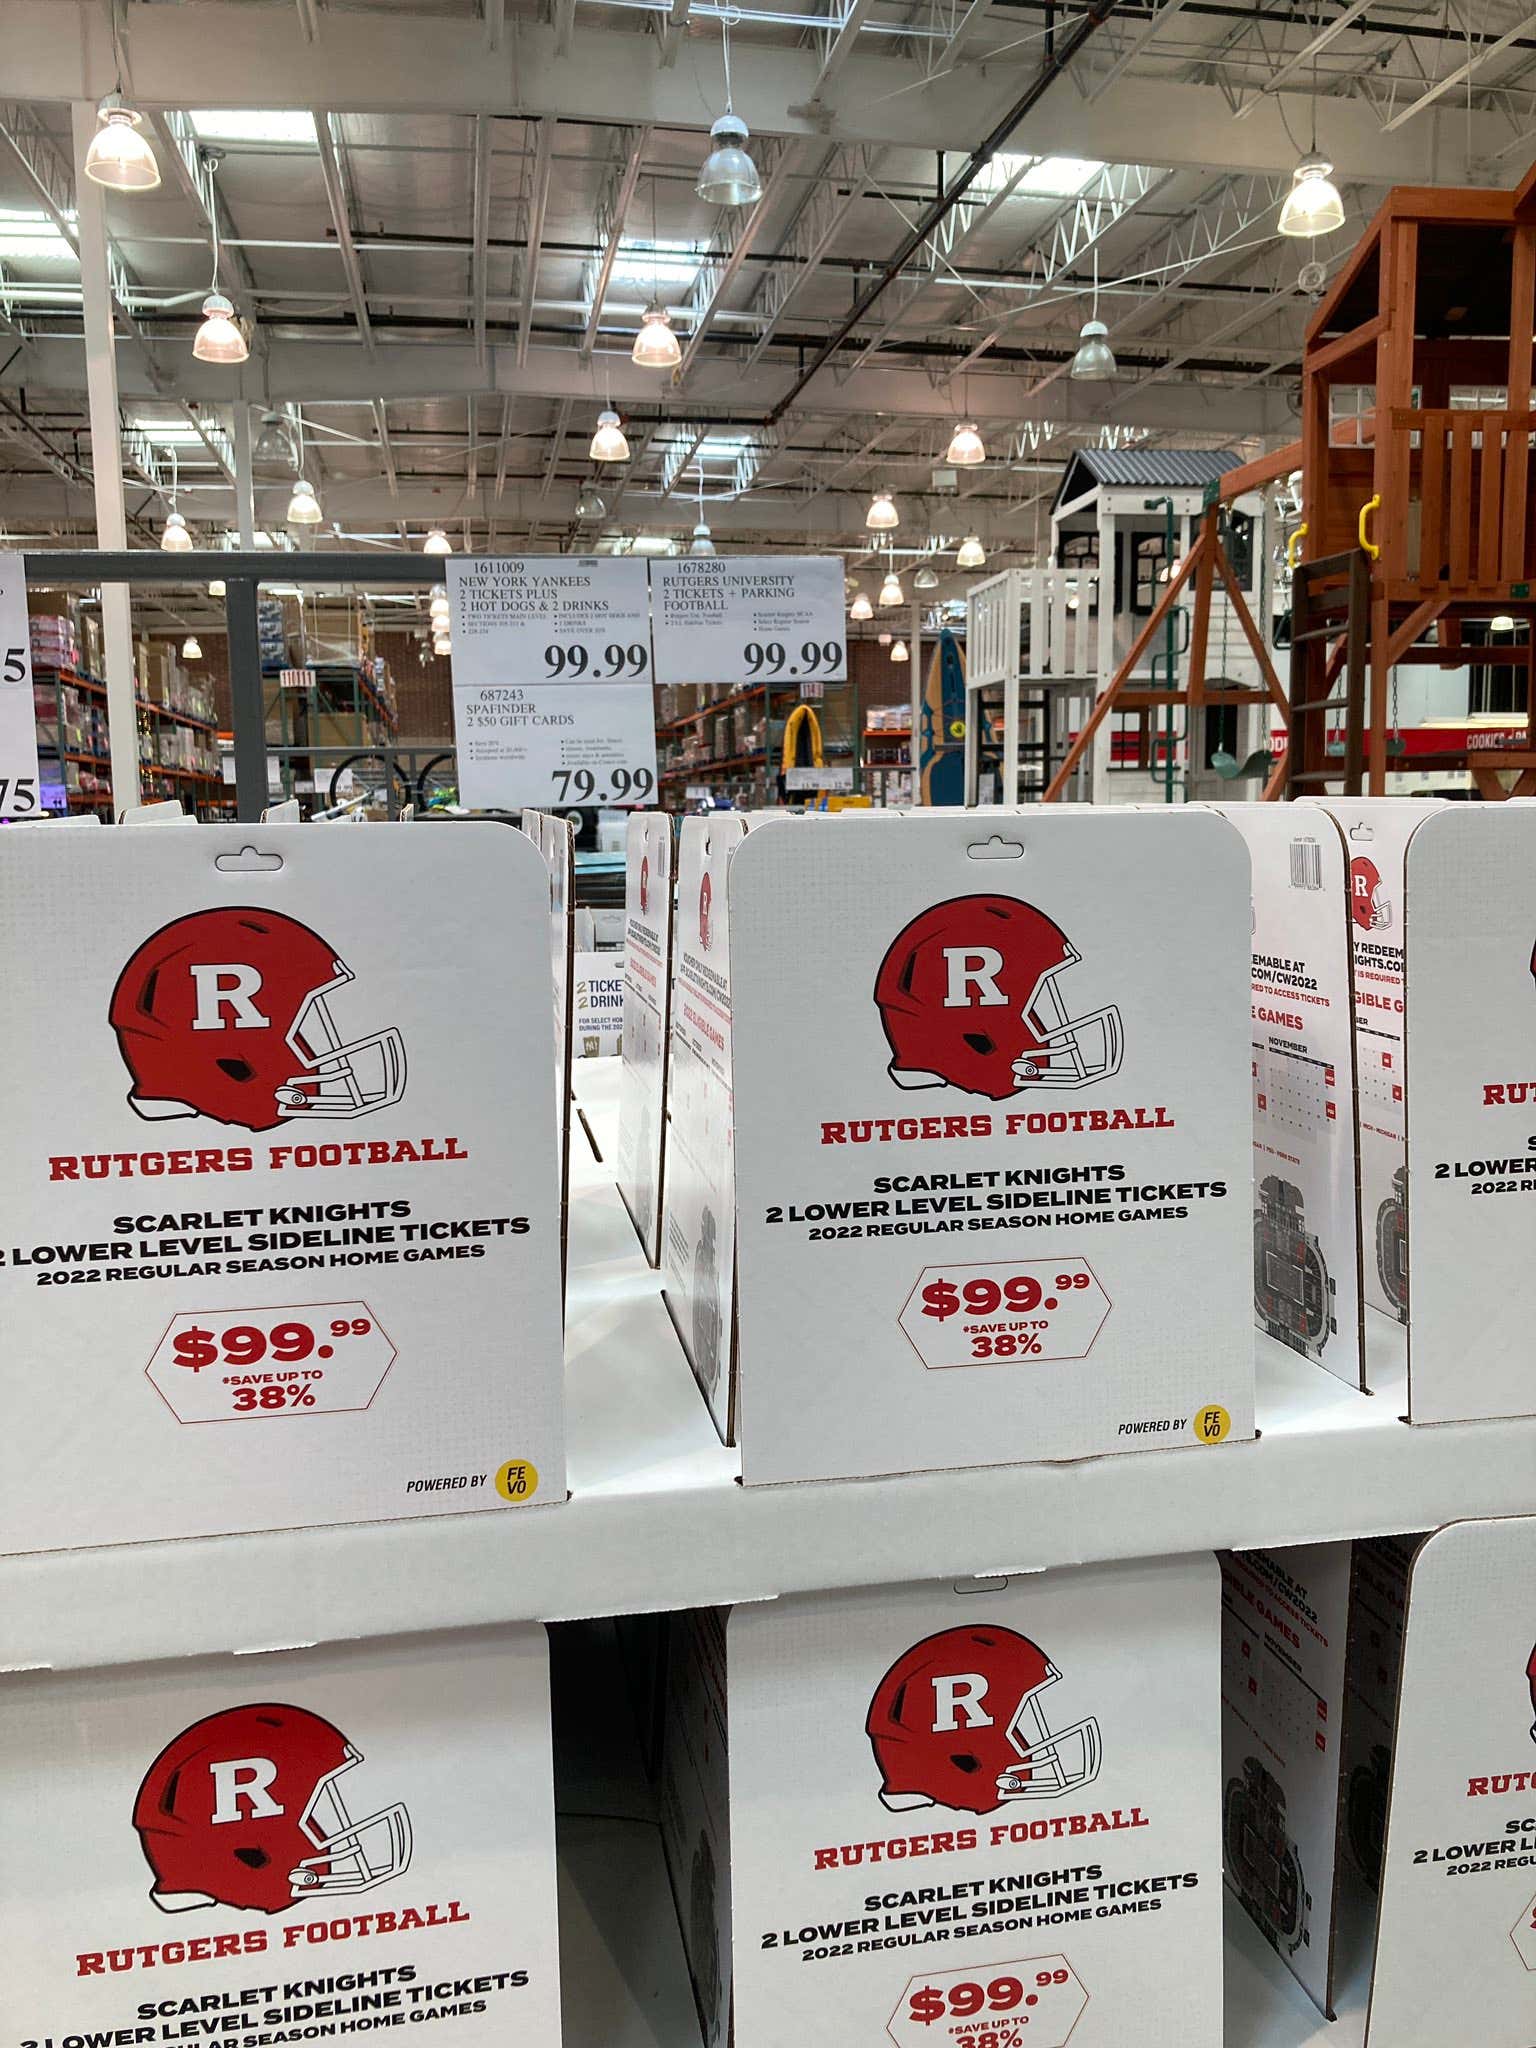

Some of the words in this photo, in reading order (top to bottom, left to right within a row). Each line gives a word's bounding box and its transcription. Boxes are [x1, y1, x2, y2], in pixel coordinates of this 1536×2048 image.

[474, 562, 524, 574] 1611009
[678, 563, 726, 574] 1678280
[459, 577, 490, 587] NEW
[492, 577, 527, 587] YORK
[532, 577, 591, 587] YANKEES
[664, 577, 719, 587] RUTGERS
[723, 576, 795, 586] UNIVERSITY
[664, 589, 670, 599] 2
[675, 589, 724, 599] TICKETS
[729, 590, 736, 598] +
[742, 588, 795, 598] PARKING
[460, 590, 466, 599] 2
[470, 589, 522, 599] TICKETS
[527, 589, 558, 599] PLUS
[664, 601, 728, 611] FOOTBALL
[461, 601, 467, 612] 2
[471, 601, 498, 611] HOT
[501, 601, 536, 611] DOGS
[539, 601, 549, 611] &
[553, 601, 559, 611] 2
[563, 601, 609, 611] DRINKS
[4, 648, 26, 682] 5
[545, 644, 647, 678] 99.99
[744, 642, 842, 676] 99.99
[480, 690, 524, 701] 687243
[466, 704, 536, 715] SPAFINDER
[468, 717, 473, 727] 2
[478, 716, 497, 727] $50
[500, 716, 529, 726] GIFT
[532, 715, 575, 726] CARDS
[552, 768, 654, 802] 79.99
[942, 945, 1009, 1008] R
[1293, 962, 1305, 973] AT
[1366, 972, 1400, 985] REQUIRED
[189, 963, 271, 1030] R
[577, 981, 587, 994] 2
[1265, 986, 1274, 994] TO
[1274, 989, 1300, 1000] ACCESS
[1300, 994, 1330, 1007] TICKETS
[579, 998, 588, 1009] 2
[1258, 1008, 1303, 1030] GAMES
[1269, 1036, 1308, 1054] NOVEMBER
[1483, 1082, 1536, 1105] RU
[820, 1114, 992, 1145] RUTGERS
[1006, 1107, 1175, 1135] FOOTBALL
[49, 1147, 253, 1181] RUTGERS
[270, 1137, 468, 1169] FOOTBALL
[1435, 1164, 1450, 1179] 2
[1455, 1158, 1536, 1177] LOWER
[873, 1171, 1000, 1194] SCARLET
[1005, 1165, 1125, 1186] KNIGHTS
[1471, 1181, 1517, 1194] 2022
[766, 1206, 783, 1224] 2
[788, 1200, 890, 1222] LOWER
[895, 1194, 982, 1216] LEVEL
[986, 1186, 1112, 1210] SIDELINE
[1115, 1181, 1227, 1202] TICKETS
[113, 1208, 264, 1234] SCARLET
[270, 1200, 410, 1224] KNIGHTS
[808, 1225, 863, 1241] 2022
[866, 1219, 964, 1237] REGULAR
[968, 1214, 1052, 1231] SEASON
[1055, 1210, 1114, 1226] HOME
[1118, 1206, 1188, 1221] GAMES
[13, 1242, 133, 1266] LOWER
[140, 1236, 243, 1258] LEVEL
[248, 1225, 396, 1253] SIDELINE
[400, 1217, 530, 1243] TICKETS
[37, 1269, 101, 1286] 2022
[106, 1262, 222, 1282] REGULAR
[226, 1255, 325, 1275] SEASON
[330, 1250, 399, 1268] HOME
[403, 1245, 486, 1262] GAMES
[1010, 1322, 1028, 1332] UP
[1029, 1321, 1049, 1330] TO
[971, 1333, 1042, 1358] 38%
[277, 1372, 301, 1383] UP
[302, 1370, 323, 1381] TO
[232, 1383, 315, 1412] 38%
[1118, 1420, 1169, 1435] POWERED
[1172, 1419, 1187, 1431] BY
[406, 1476, 467, 1494] POWERED
[471, 1474, 487, 1489] BY
[931, 1672, 994, 1733] R
[209, 1757, 284, 1825] R
[1467, 1772, 1536, 1797] RUT
[1505, 1818, 1536, 1834] SC
[814, 1829, 977, 1870] RUTGERS
[989, 1807, 1149, 1847] FOOTBALL
[1413, 1850, 1428, 1864] 2
[1432, 1840, 1516, 1862] LOWER
[1521, 1837, 1536, 1851] L
[1446, 1862, 1492, 1876] 2022
[864, 1881, 984, 1911] SCARLET
[989, 1865, 1103, 1893] KNIGHTS
[761, 1933, 779, 1949] 2
[783, 1917, 879, 1946] LOWER
[884, 1904, 968, 1930] LEVEL
[971, 1887, 1090, 1917] SIDELINE
[1094, 1872, 1199, 1900] TICKETS
[77, 1930, 267, 1977] RUTGERS
[283, 1901, 470, 1949] FOOTBALL
[802, 1942, 854, 1962] 2022
[857, 1927, 950, 1954] REGULAR
[953, 1916, 1033, 1940] SEASON
[1037, 1907, 1093, 1927] HOME
[1096, 1898, 1162, 1918] GAMES
[137, 1986, 278, 2020] SCARLET
[284, 1964, 417, 1998] KNIGHTS
[162, 2014, 258, 2041] LEVEL
[264, 1989, 402, 2025] SIDELINE
[406, 1970, 529, 2003] TICKETS
[243, 2022, 336, 2048] SEASON
[340, 2010, 405, 2032] HOME
[410, 1999, 487, 2022] GAMES
[992, 2019, 1009, 2029] UP
[1010, 2016, 1029, 2026] TO
